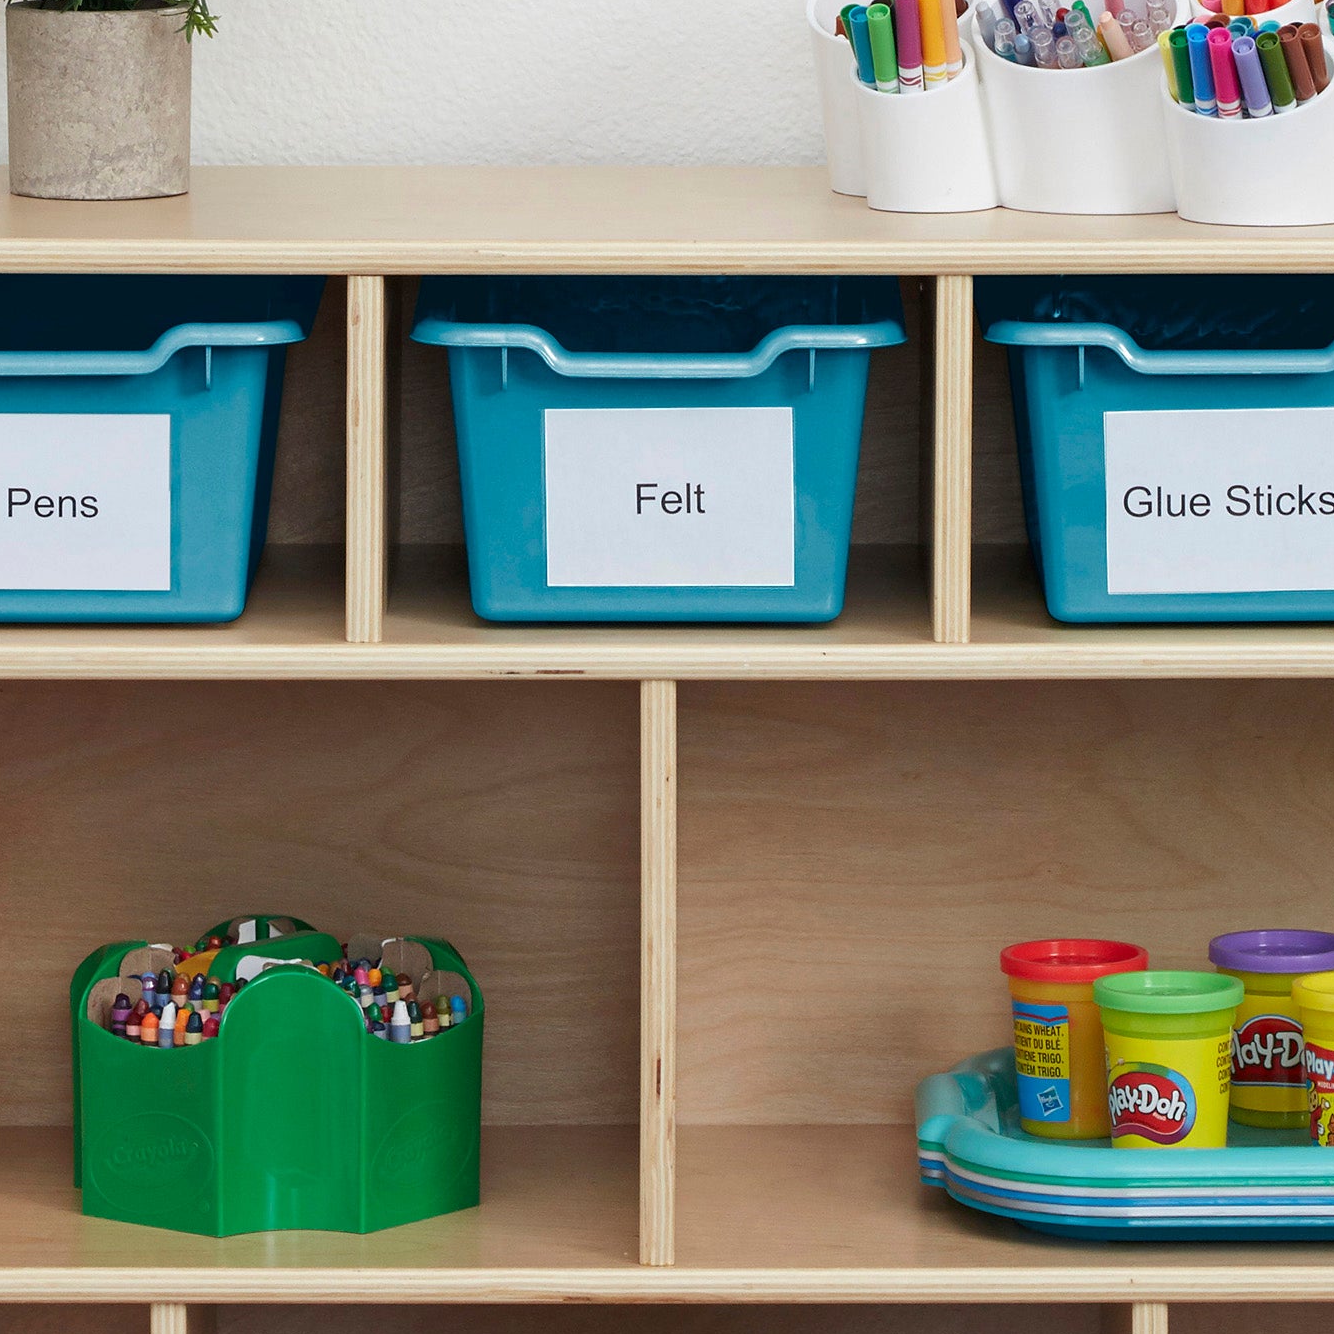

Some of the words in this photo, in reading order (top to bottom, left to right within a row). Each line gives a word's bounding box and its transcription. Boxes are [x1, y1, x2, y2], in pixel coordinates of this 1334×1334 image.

[7, 487, 99, 519] Pens
[636, 482, 706, 515] Felt
[1123, 485, 1212, 518] Glue
[1033, 1023, 1064, 1037] WHEAT.
[1033, 1038, 1044, 1050] DU
[1045, 1037, 1064, 1050] BLÉ.
[1037, 1052, 1065, 1064] TRIGO.
[1037, 1064, 1064, 1078] TRIGO.
[1108, 1083, 1186, 1126] Play-Doh
